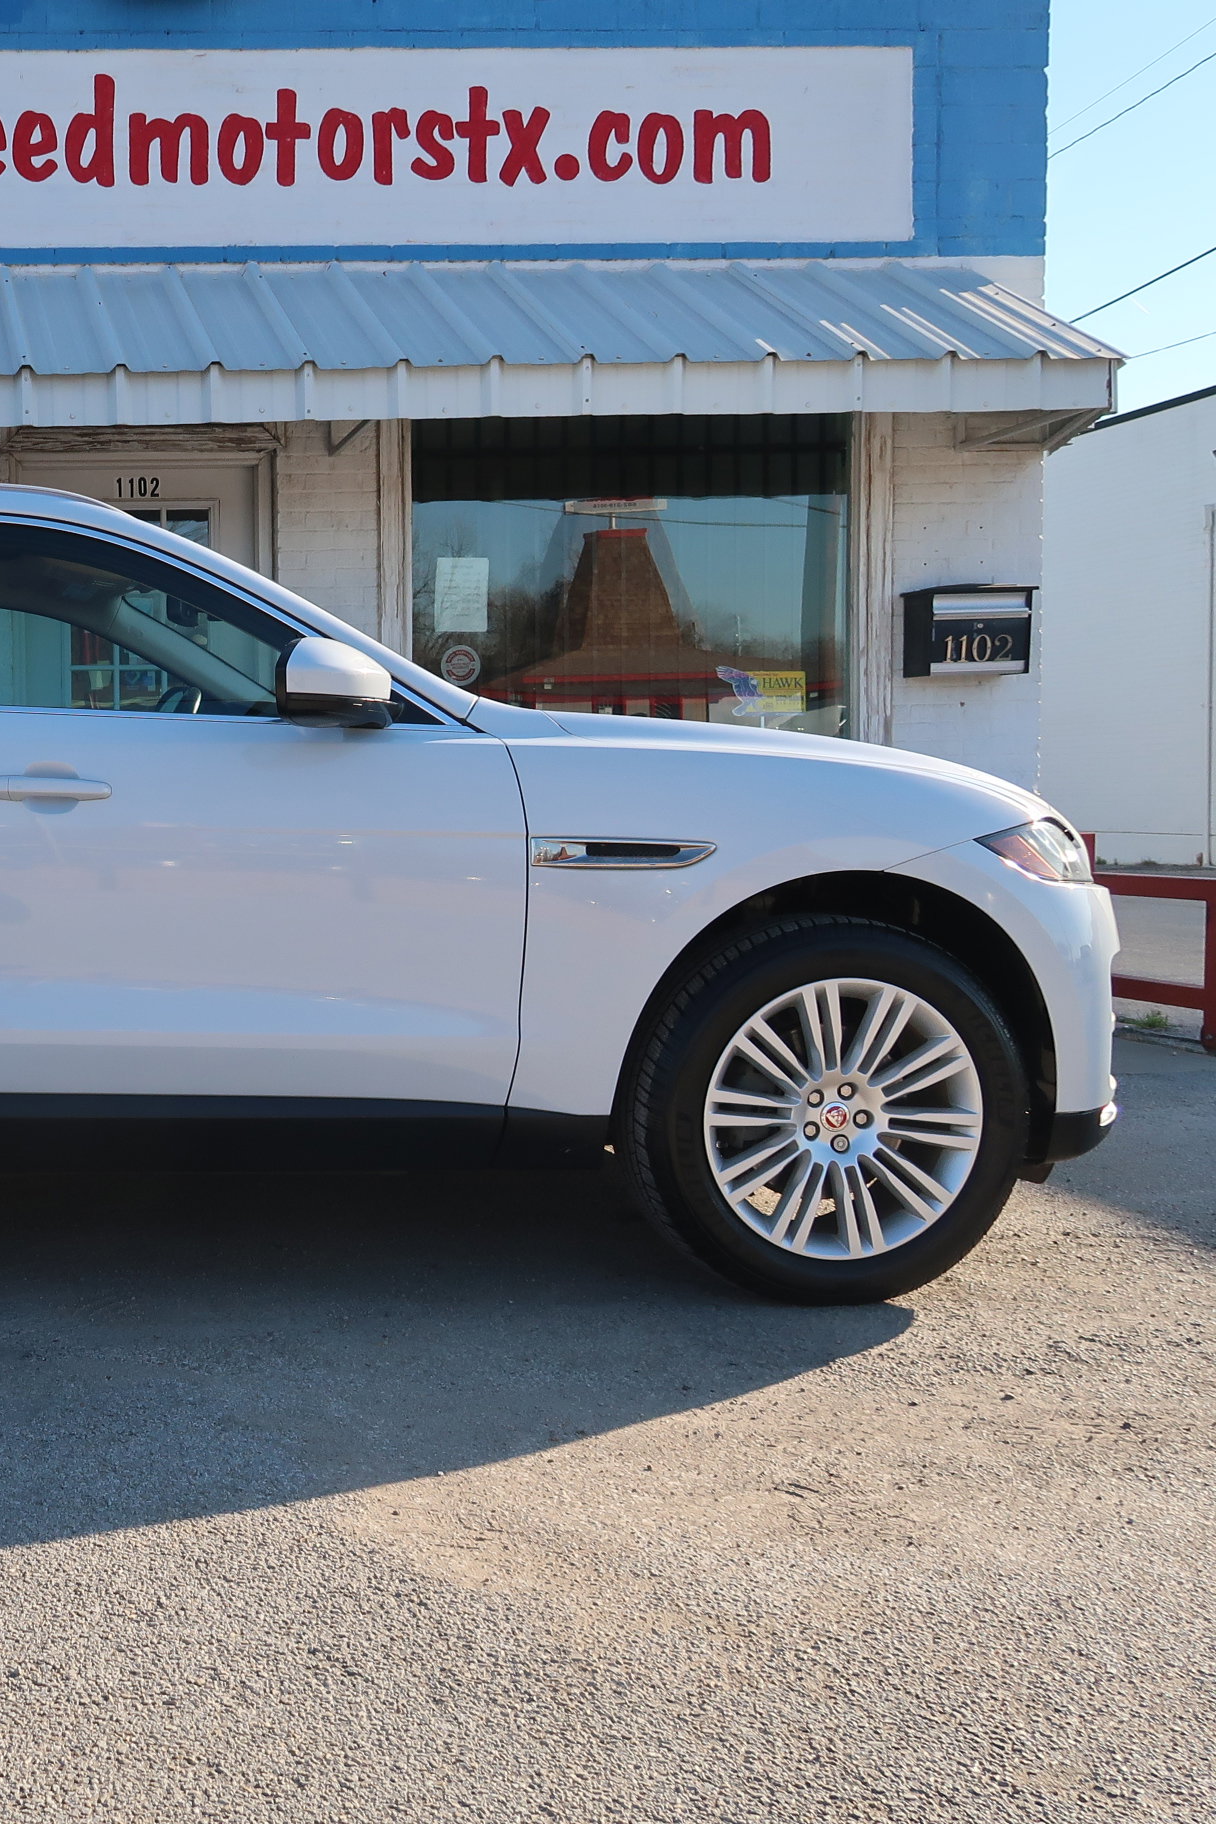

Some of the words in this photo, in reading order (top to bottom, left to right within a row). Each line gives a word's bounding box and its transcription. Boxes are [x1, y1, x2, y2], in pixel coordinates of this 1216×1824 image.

[116, 476, 160, 498] 1102
[943, 634, 1013, 663] 1102
[762, 677, 803, 689] HAWK
